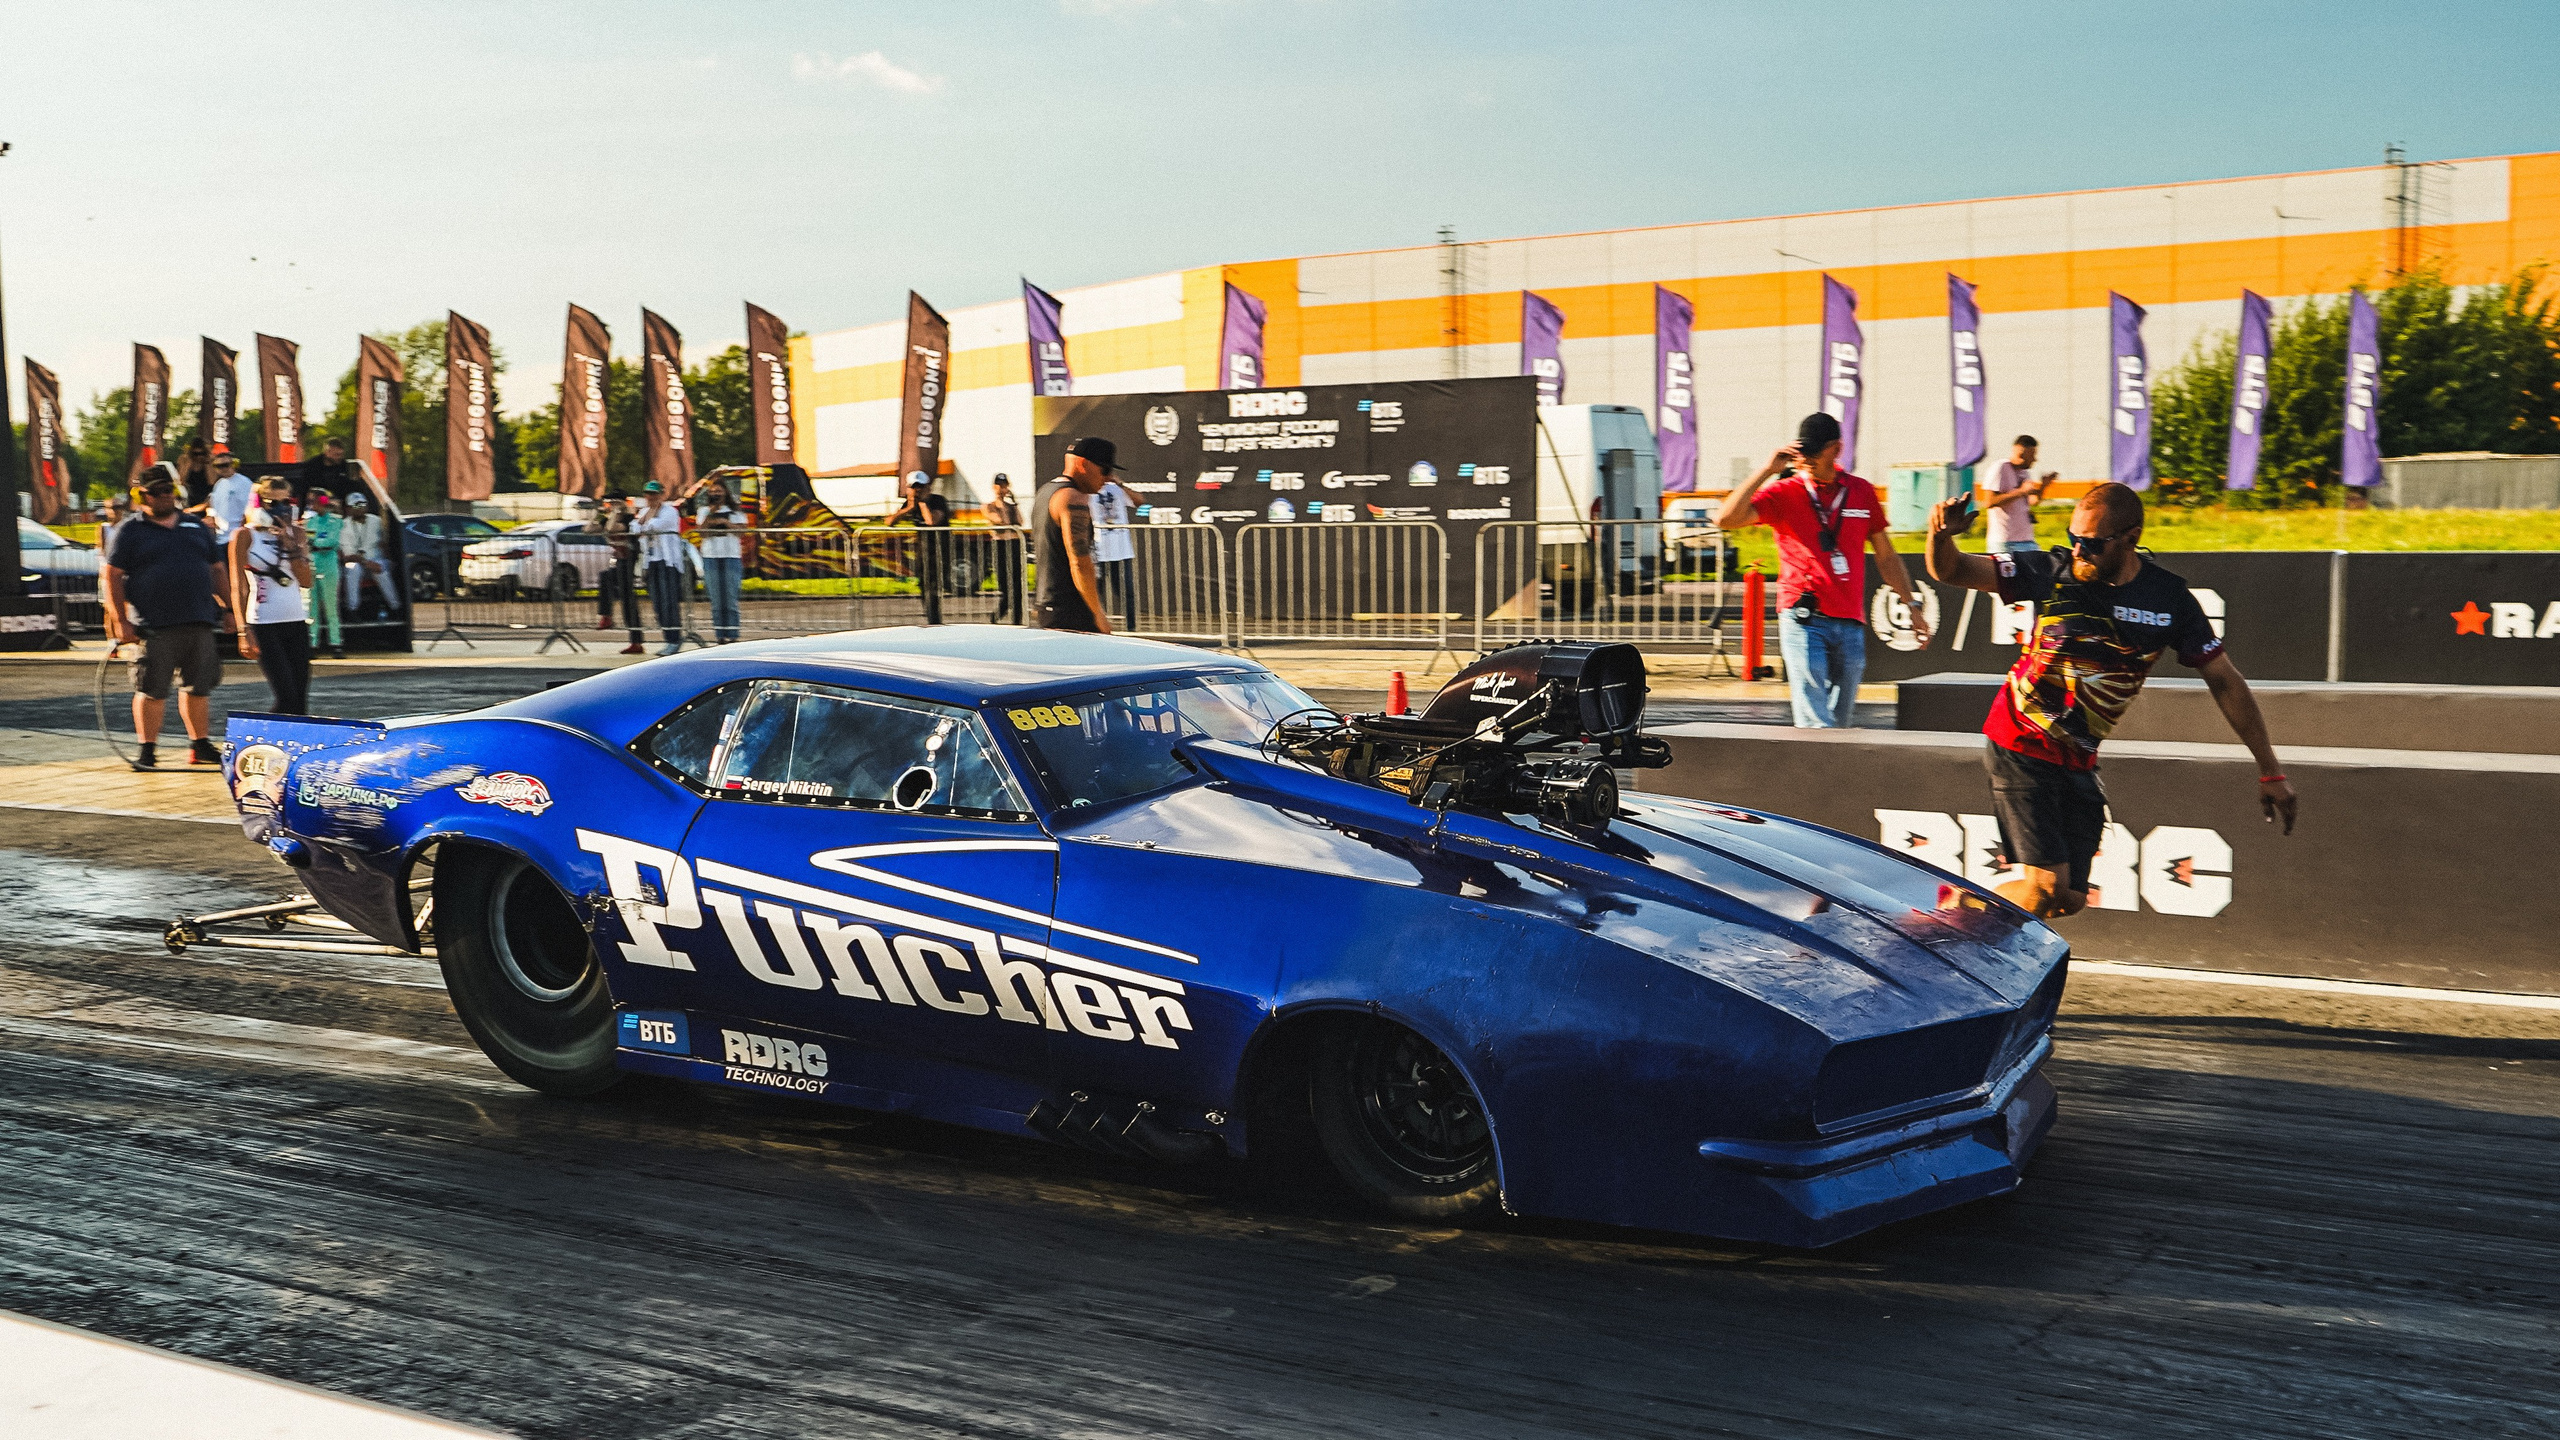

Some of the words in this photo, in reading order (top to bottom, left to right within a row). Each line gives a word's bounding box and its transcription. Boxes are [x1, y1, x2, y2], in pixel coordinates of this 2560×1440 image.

[1229, 354, 1257, 390] ТБ
[1830, 341, 1859, 397] ВТБ
[1953, 330, 1981, 385] ВТБ
[1665, 352, 1692, 408] ВТБ
[2118, 355, 2146, 410] ВТБ
[2239, 354, 2267, 410] ВТБ
[2350, 353, 2376, 408] ВТБ
[1228, 391, 1308, 418] RDRC
[1270, 472, 1305, 491] ВТБ
[1473, 466, 1511, 485] ВТБ
[1321, 504, 1356, 522] ВТБ
[2113, 605, 2171, 627] RDRC
[1007, 705, 1081, 731] 888
[741, 777, 788, 795] Sergey
[787, 780, 833, 797] Nikitin
[575, 828, 1194, 1050] Puncher
[639, 1020, 676, 1044] ВТБ
[721, 1029, 828, 1078] RDRC
[725, 1066, 829, 1094] TECHNOLOGY
